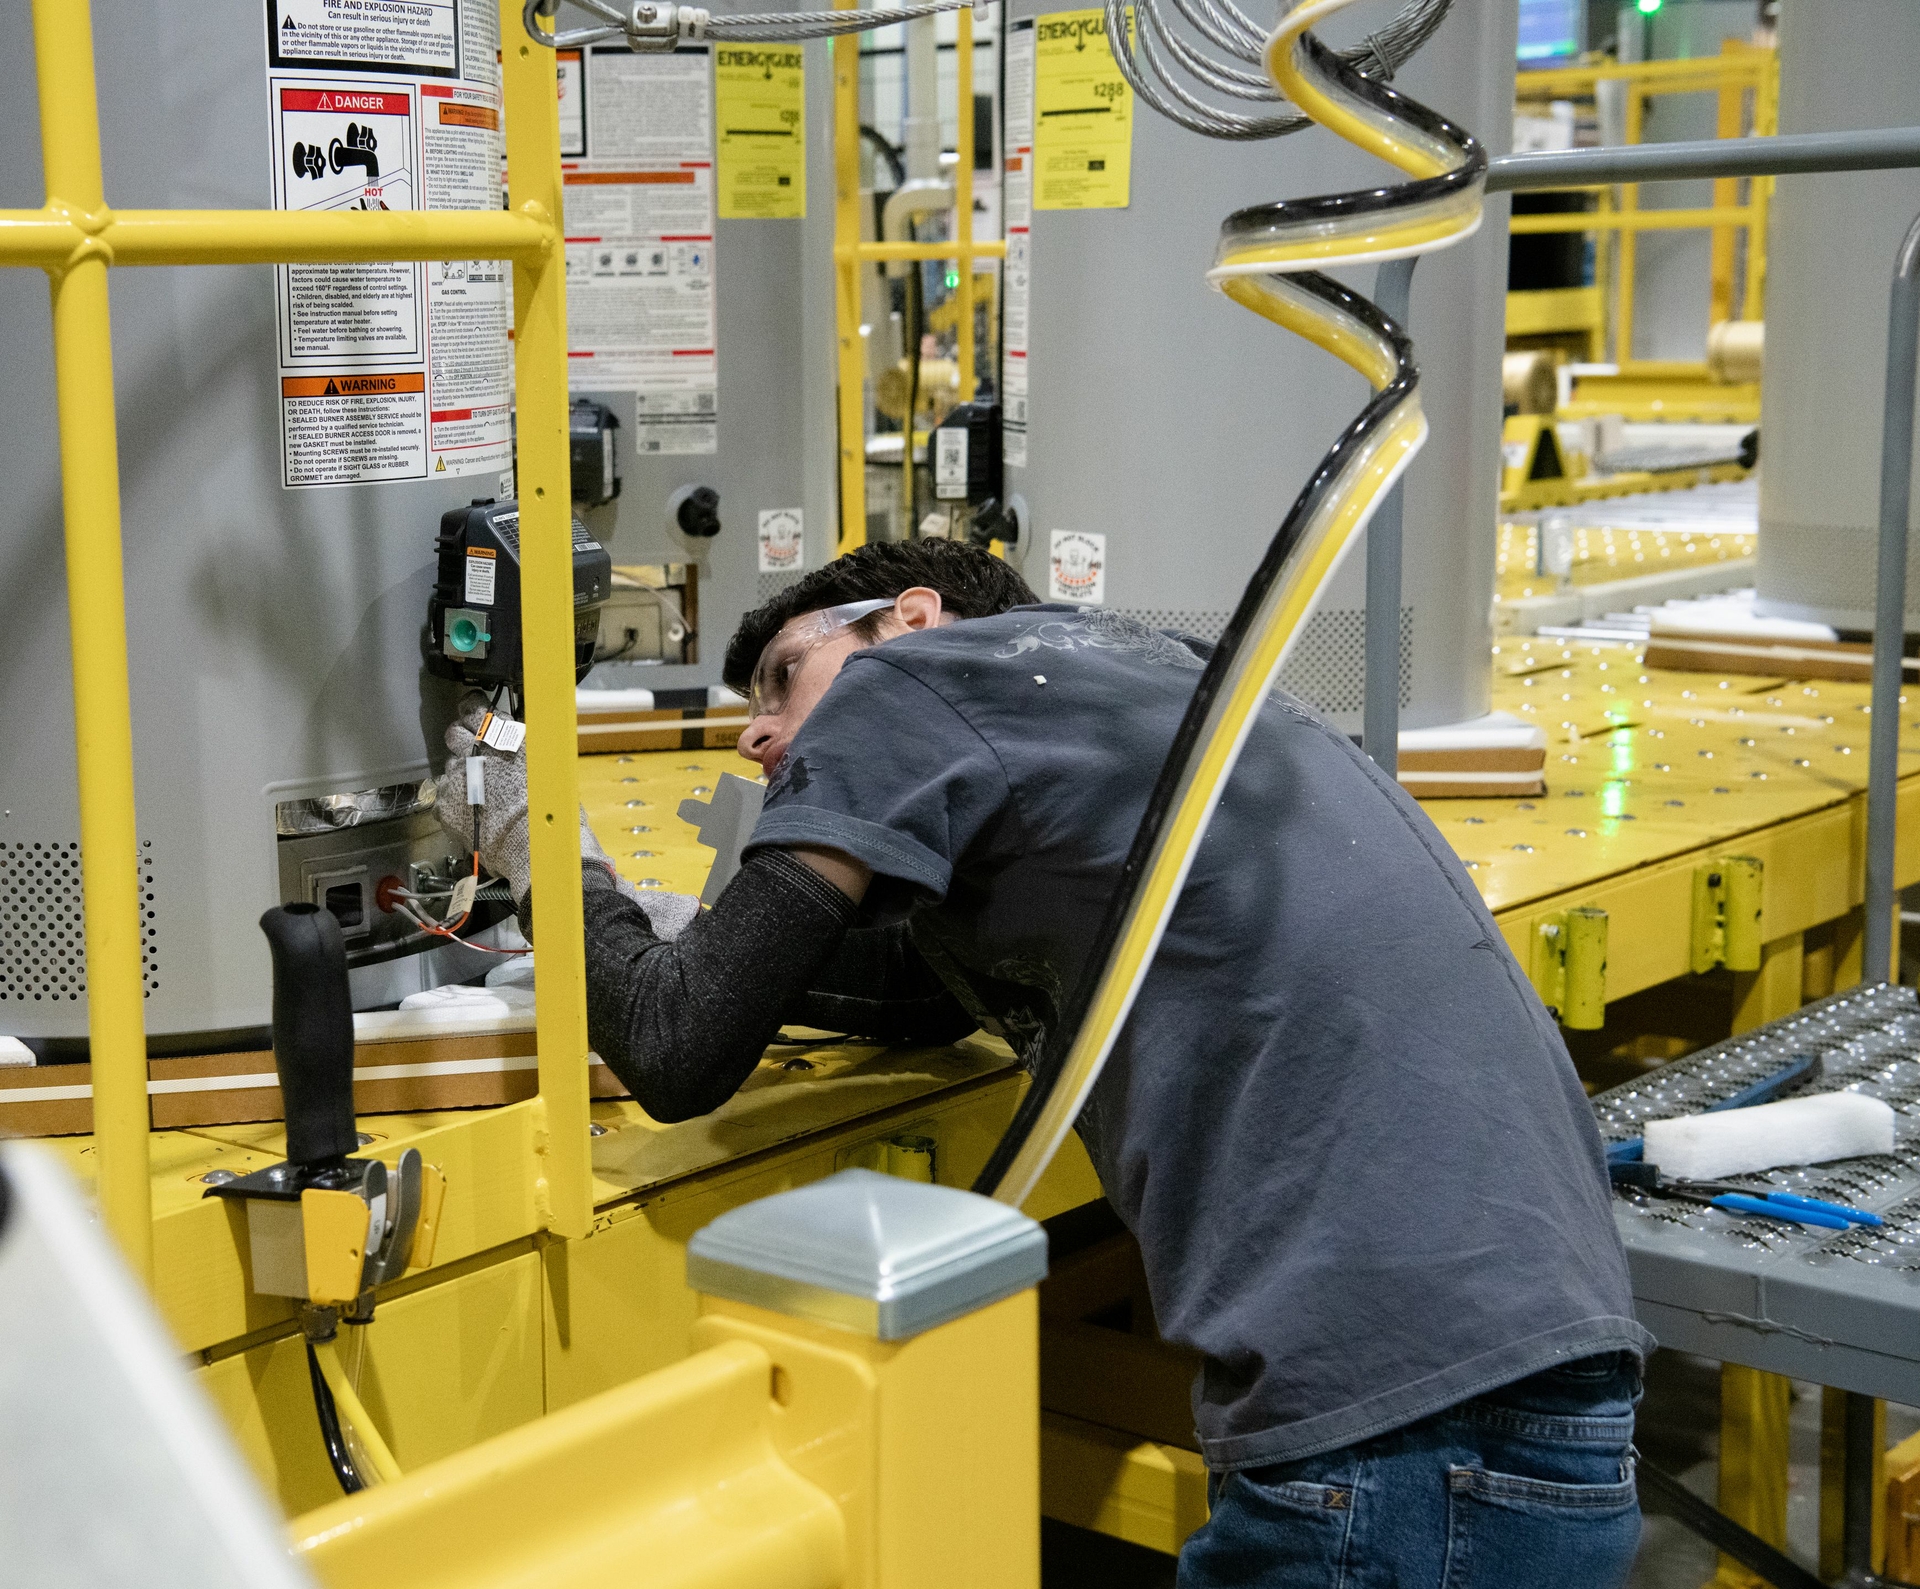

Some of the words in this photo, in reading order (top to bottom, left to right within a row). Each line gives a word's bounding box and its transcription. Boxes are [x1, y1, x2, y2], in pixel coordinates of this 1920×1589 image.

[324, 0, 341, 8] FIRE
[344, 1, 362, 10] AND
[365, 3, 405, 13] EXPLOSION
[407, 6, 433, 16] HAZARD
[393, 15, 408, 27] injury
[416, 18, 430, 26] death
[283, 49, 312, 57] appliance
[369, 52, 383, 61] injury
[335, 96, 383, 109] DANGER
[364, 188, 383, 196] HOT
[340, 379, 396, 391] WARNING
[289, 425, 319, 433] performed
[334, 423, 358, 431] qualified
